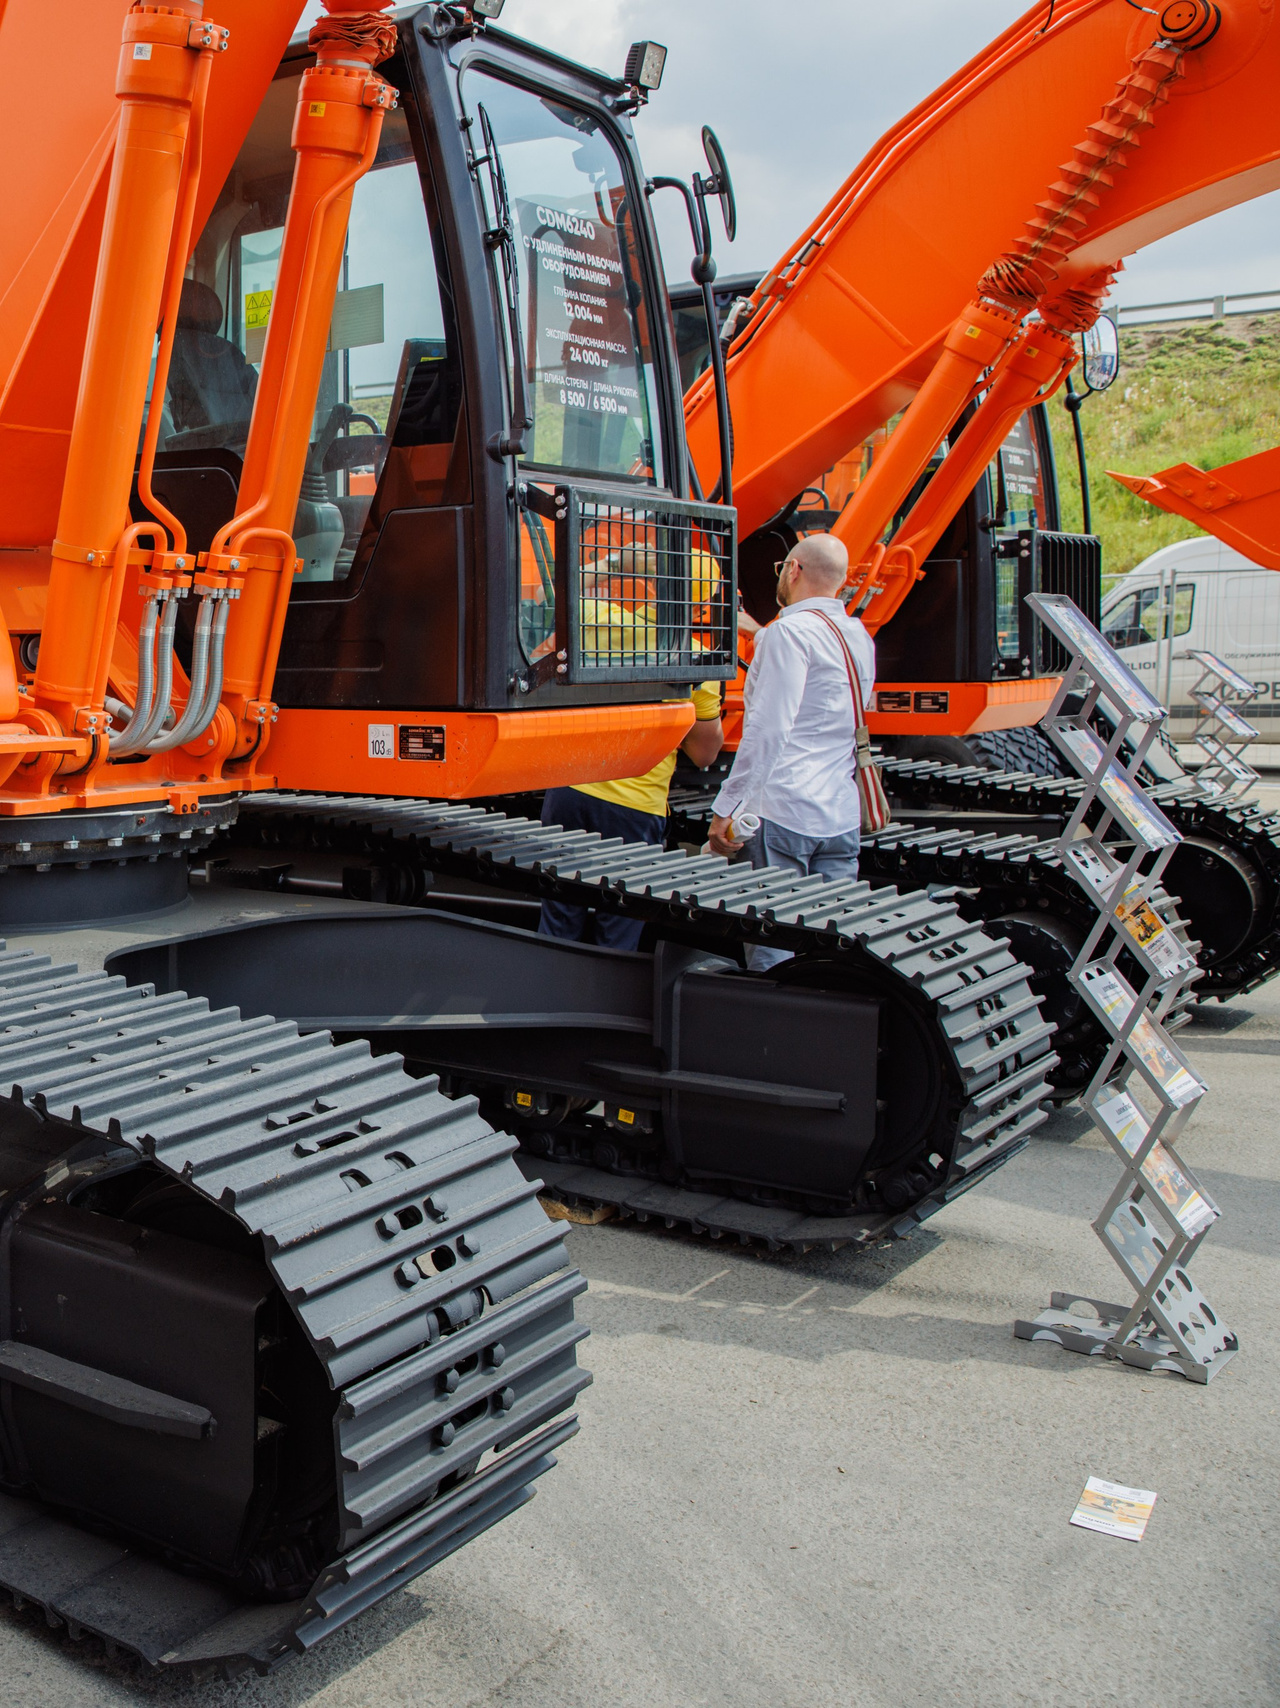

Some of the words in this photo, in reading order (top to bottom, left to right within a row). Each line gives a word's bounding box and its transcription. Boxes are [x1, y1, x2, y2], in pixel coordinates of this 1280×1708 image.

[536, 205, 596, 241] CDM6240
[523, 235, 530, 248] С
[531, 237, 587, 265] УДЛИНЕННЫМ
[586, 253, 623, 275] РАБОЧИМ
[542, 257, 611, 287] ОБОРУДОВАНИЕМ
[553, 285, 580, 301] ГЛУБИНА
[579, 292, 608, 308] КОПАНИЯ:
[545, 327, 605, 350] ЭКСПЛУАТАЦИОННАЯ
[605, 341, 628, 354] МАССА:
[544, 372, 565, 386] ДЛИНА
[565, 376, 588, 390] СТРЕЛЫ
[593, 381, 613, 394] ДЛИНА
[371, 739, 386, 756] 103
